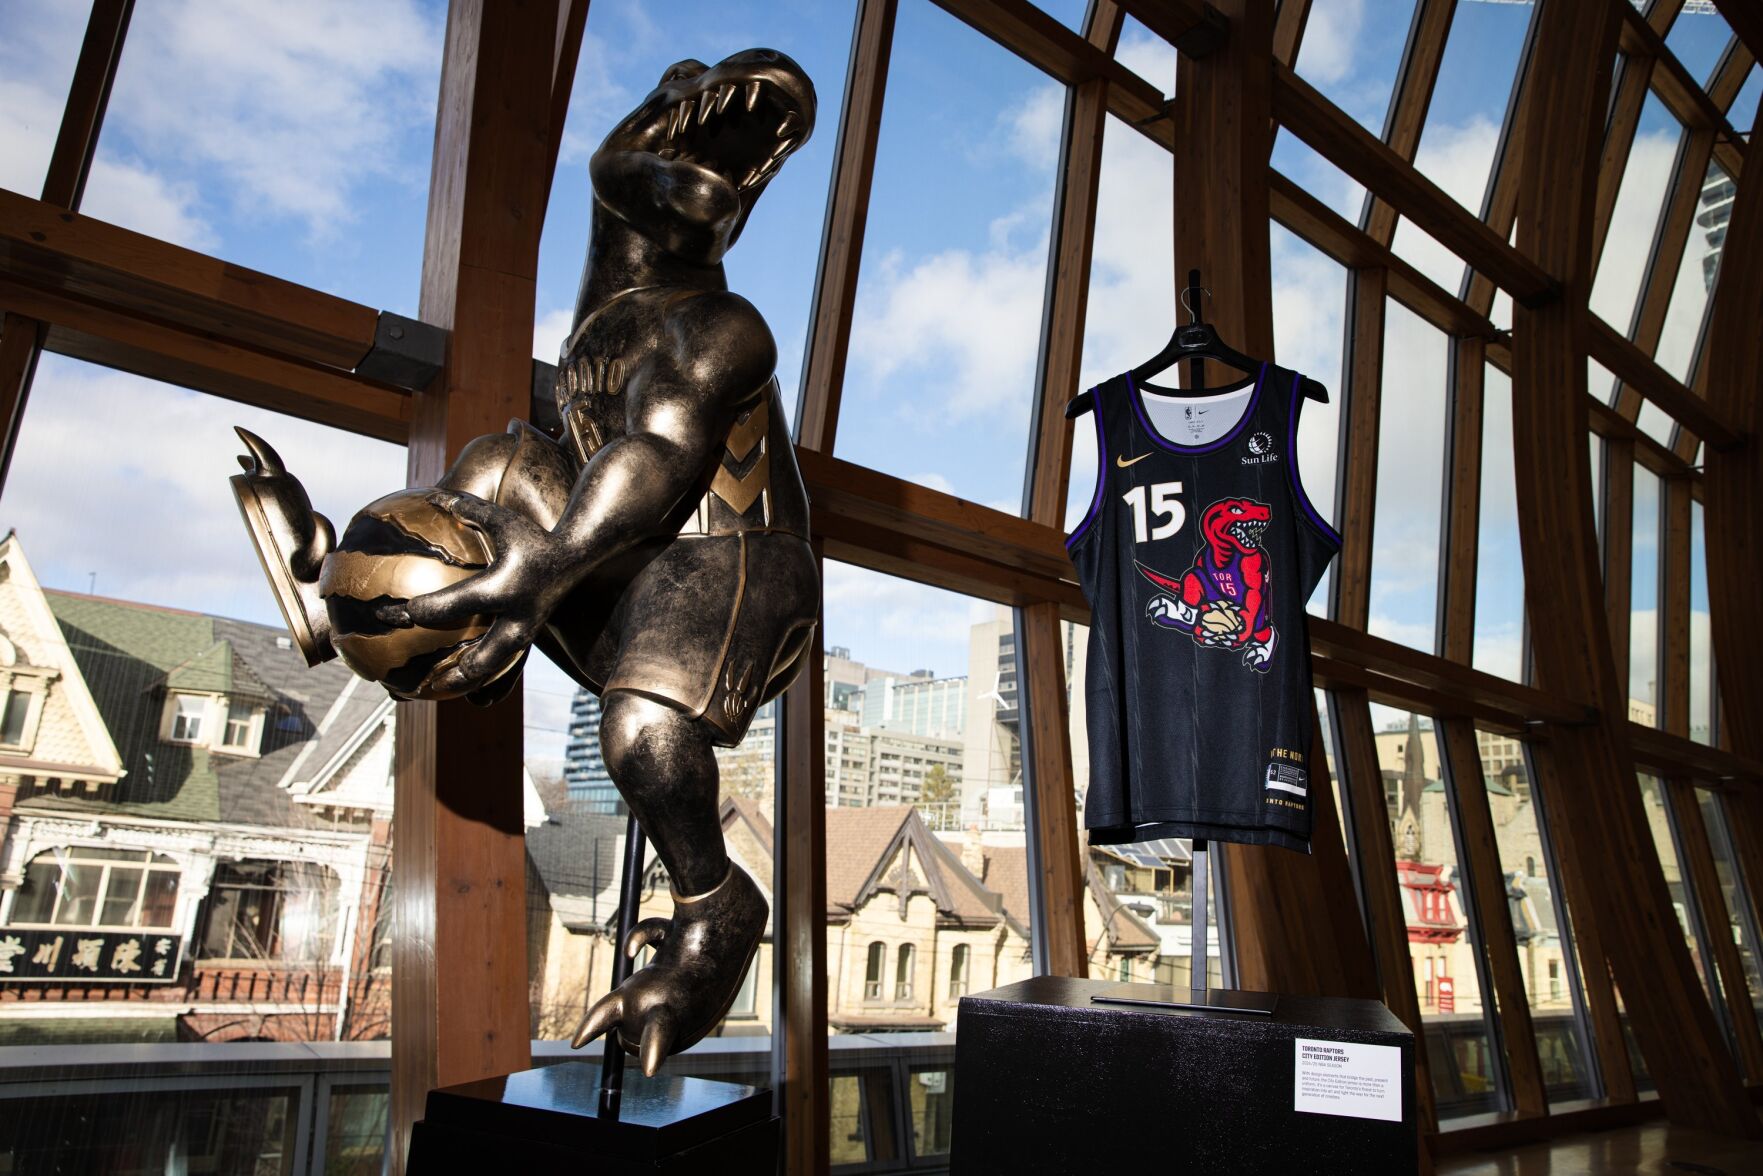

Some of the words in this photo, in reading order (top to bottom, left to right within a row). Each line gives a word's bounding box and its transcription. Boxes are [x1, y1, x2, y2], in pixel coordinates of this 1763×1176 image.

[1241, 456, 1260, 465] Sun
[1261, 453, 1278, 463] Life
[1122, 482, 1186, 544] 15
[1213, 572, 1232, 582] TOR
[1220, 582, 1236, 596] 15
[1290, 752, 1304, 762] NOR
[1285, 801, 1305, 810] RAPTORS
